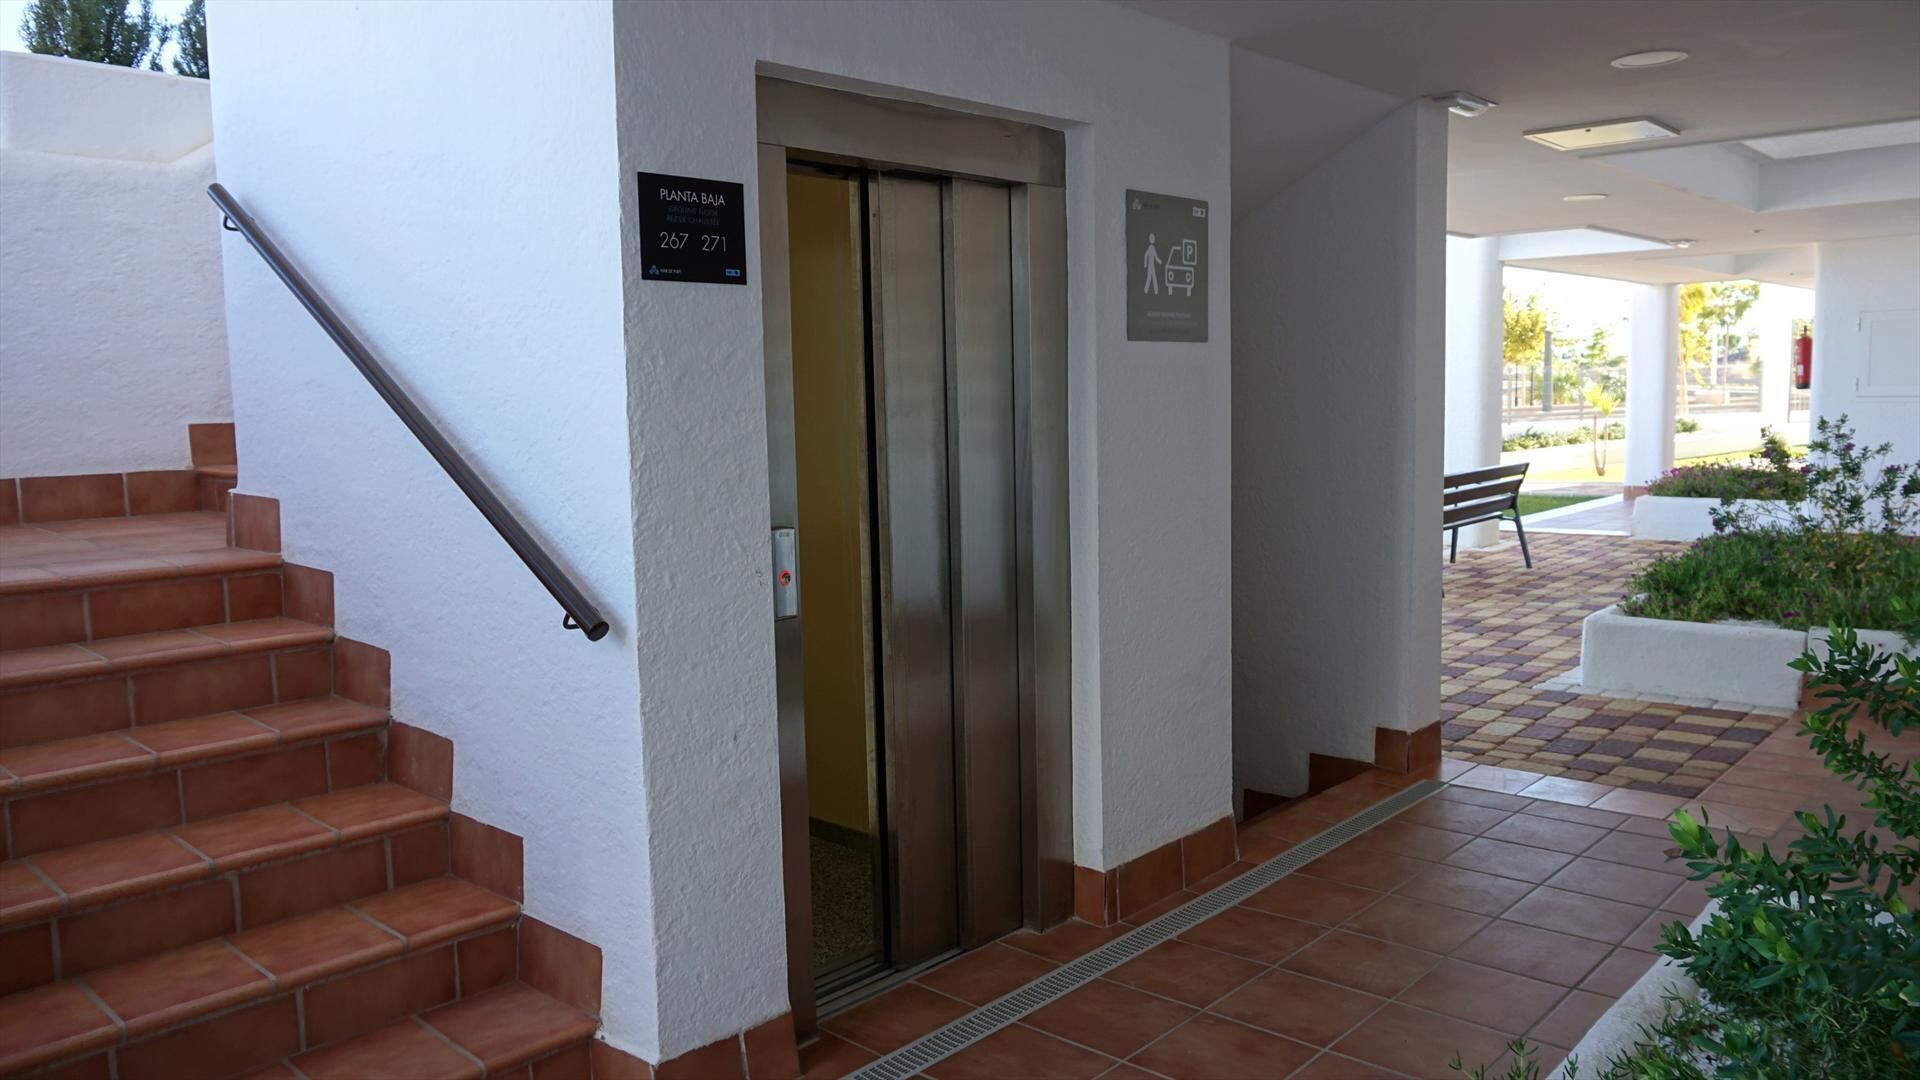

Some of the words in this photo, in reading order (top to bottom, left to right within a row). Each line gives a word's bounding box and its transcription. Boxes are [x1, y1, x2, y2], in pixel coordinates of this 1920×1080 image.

[660, 188, 698, 203] PLANTA
[701, 192, 726, 206] BAJA
[660, 231, 689, 249] 267
[701, 234, 727, 253] 271
[1187, 246, 1193, 259] P
